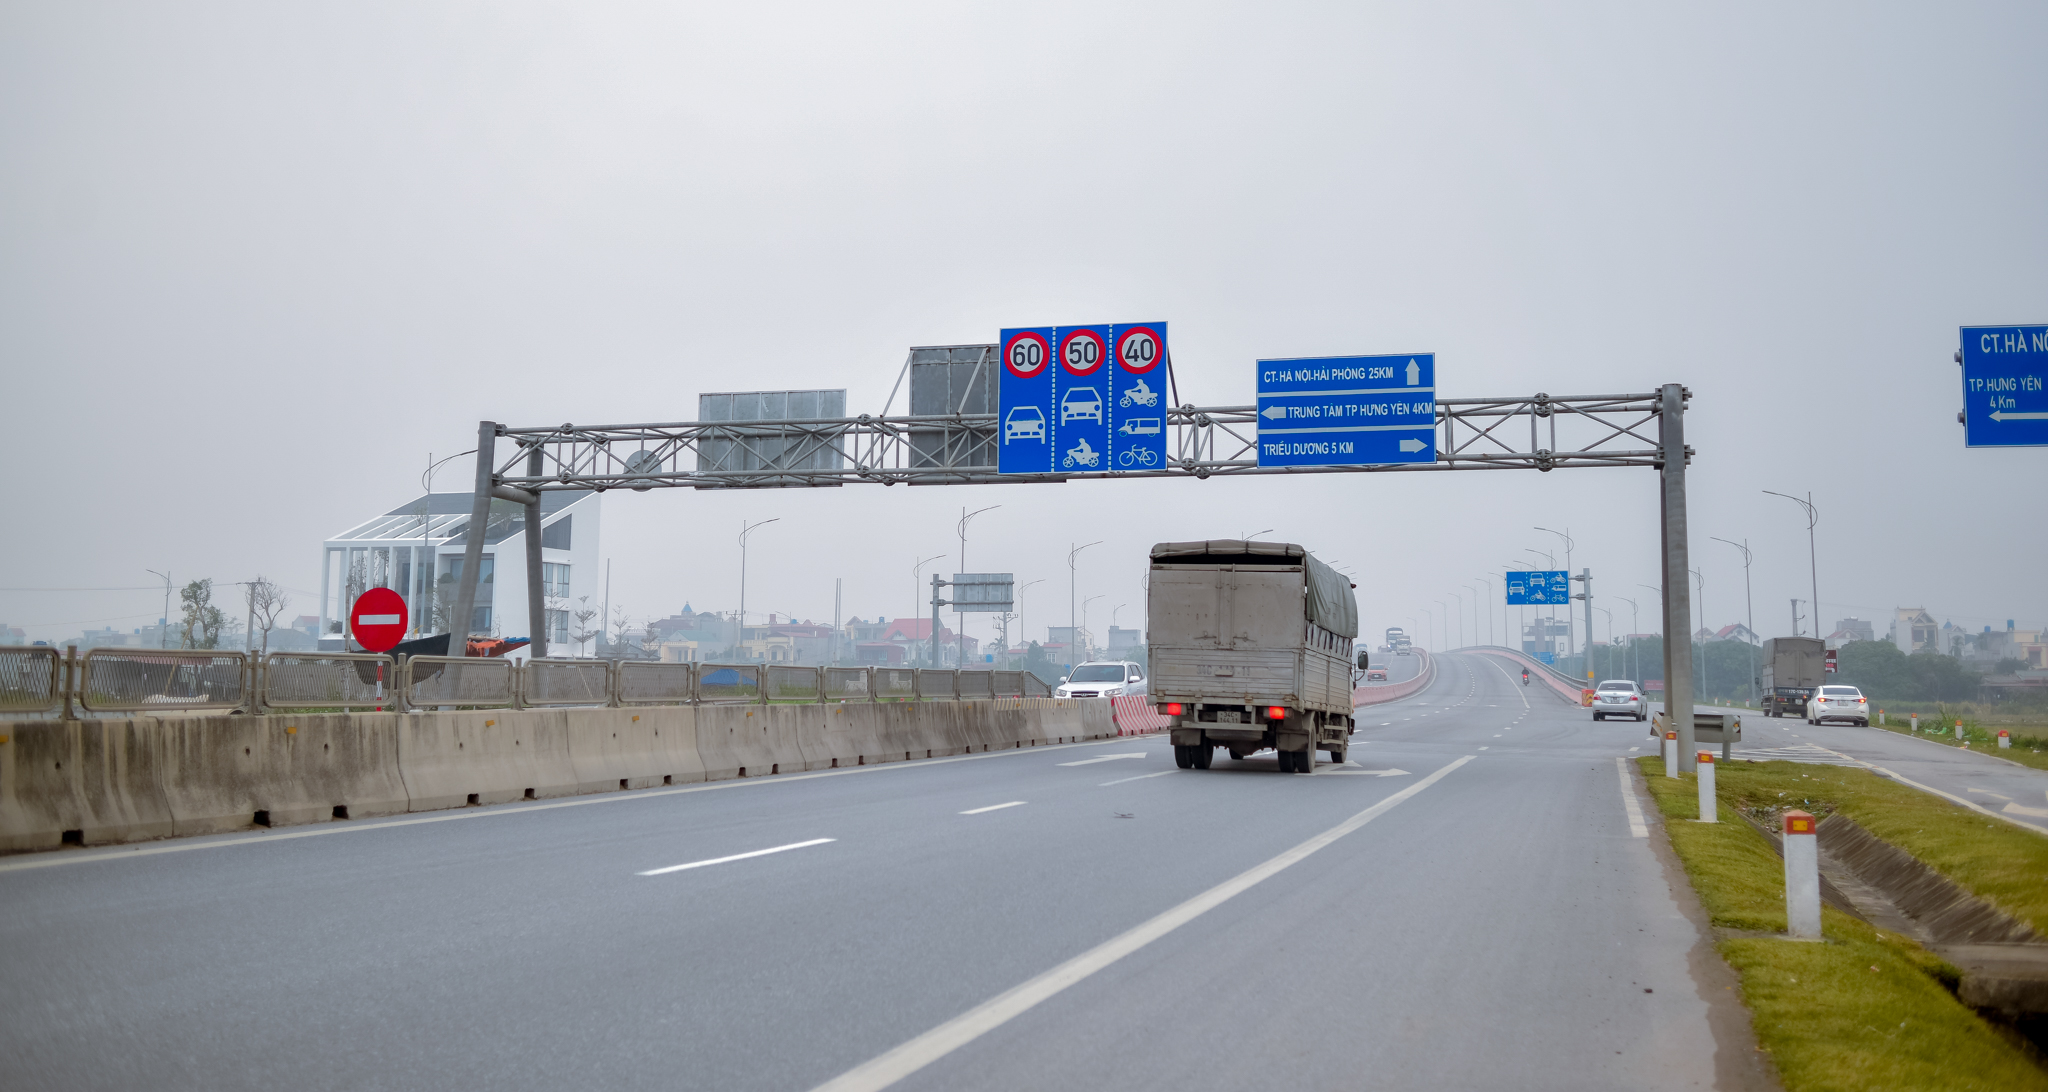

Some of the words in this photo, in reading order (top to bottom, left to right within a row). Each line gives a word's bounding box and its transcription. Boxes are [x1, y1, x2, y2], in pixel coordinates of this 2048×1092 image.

[1981, 329, 2028, 353] CT.HÀ
[1013, 343, 1041, 366] 60
[1069, 341, 1097, 364] 50
[1125, 338, 1154, 362] 40
[1332, 367, 1365, 380] PHÒNG
[1368, 367, 1393, 379] 25KM
[2020, 375, 2042, 391] YÊN
[1288, 406, 1320, 418] TRUNG
[1323, 403, 1343, 417] TÂM
[1345, 405, 1357, 416] TP
[1360, 403, 1388, 416] HƯNG
[1390, 401, 1410, 415] YÊN
[1412, 402, 1433, 414] 4KM
[1990, 395, 1996, 408] 4
[1999, 395, 2016, 408] Km
[1294, 442, 1329, 455] DƯƠNG
[1331, 442, 1337, 454] 5
[1339, 442, 1354, 453] KM
